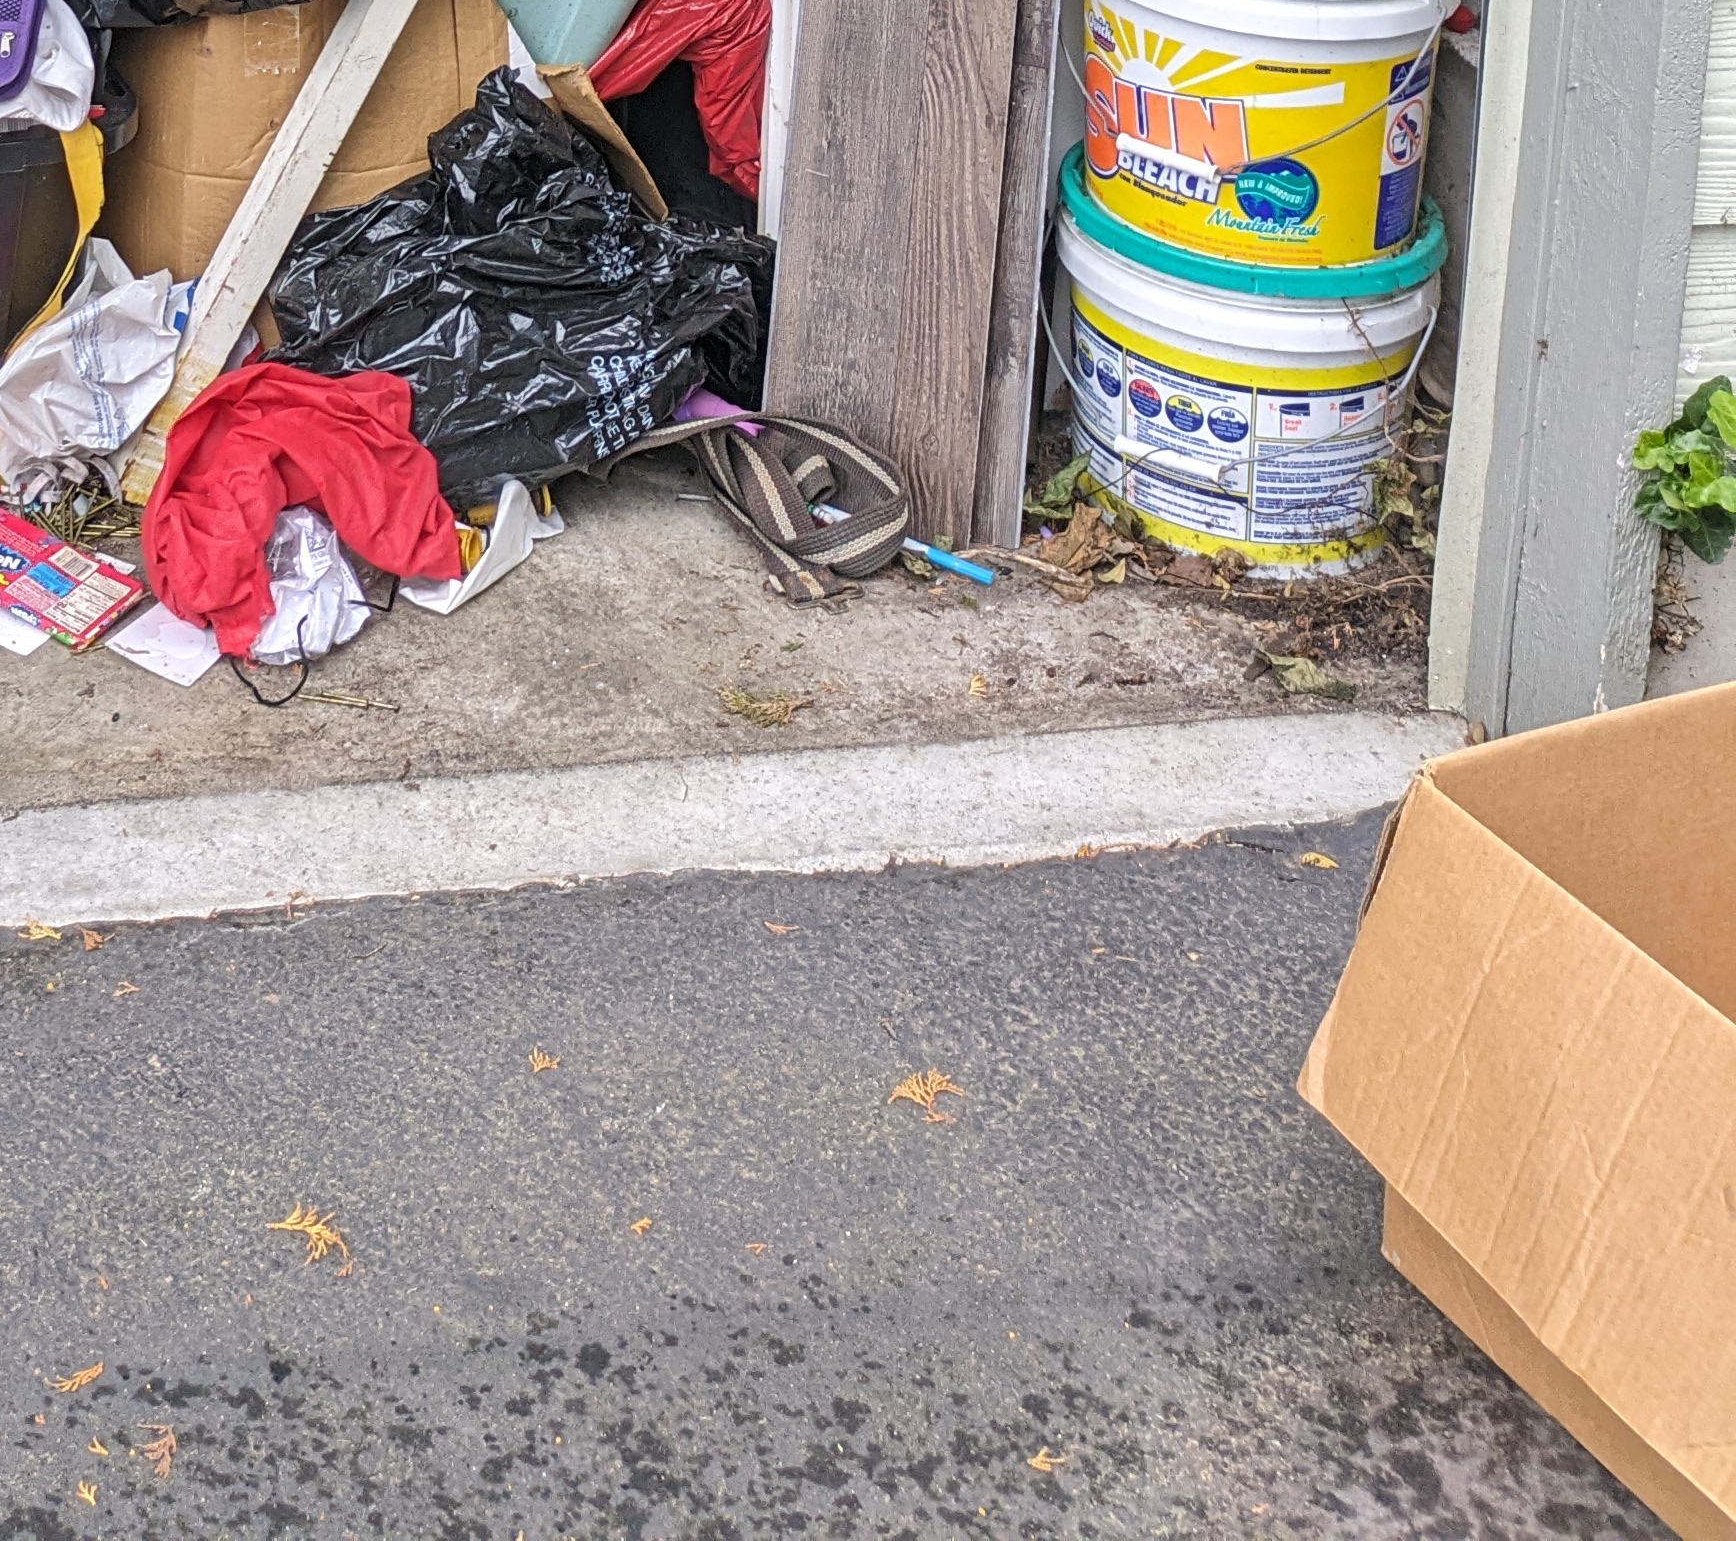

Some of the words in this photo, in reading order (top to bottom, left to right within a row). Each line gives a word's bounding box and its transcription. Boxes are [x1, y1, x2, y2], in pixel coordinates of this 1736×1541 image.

[1085, 51, 1250, 179] SUN
[1117, 147, 1222, 206] BLEACH
[1238, 177, 1256, 190] NEW
[1265, 181, 1304, 204] IMPROVED!
[1206, 207, 1284, 235] Mountain
[1280, 215, 1327, 237] Fresh
